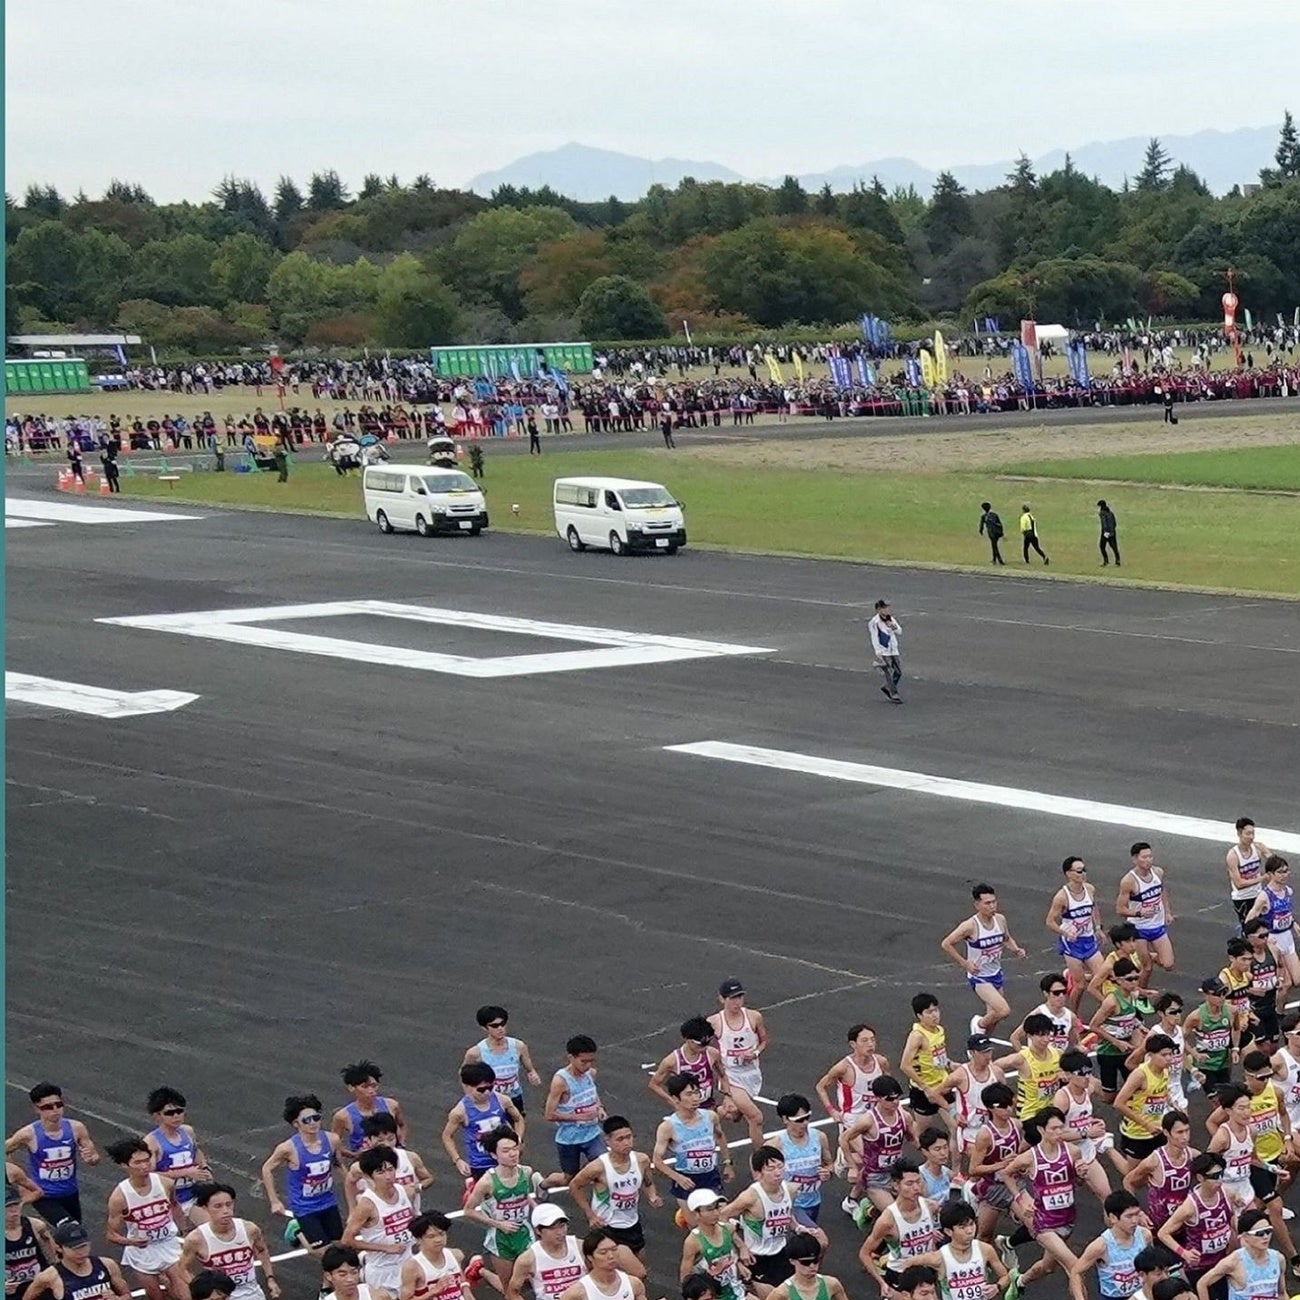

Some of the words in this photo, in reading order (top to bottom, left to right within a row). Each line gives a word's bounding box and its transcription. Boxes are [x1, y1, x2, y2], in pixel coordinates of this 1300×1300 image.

[958, 1276, 985, 1288] SAPPORO
[73, 1283, 111, 1300] KOGAKKAN
[957, 1286, 983, 1299] 499
